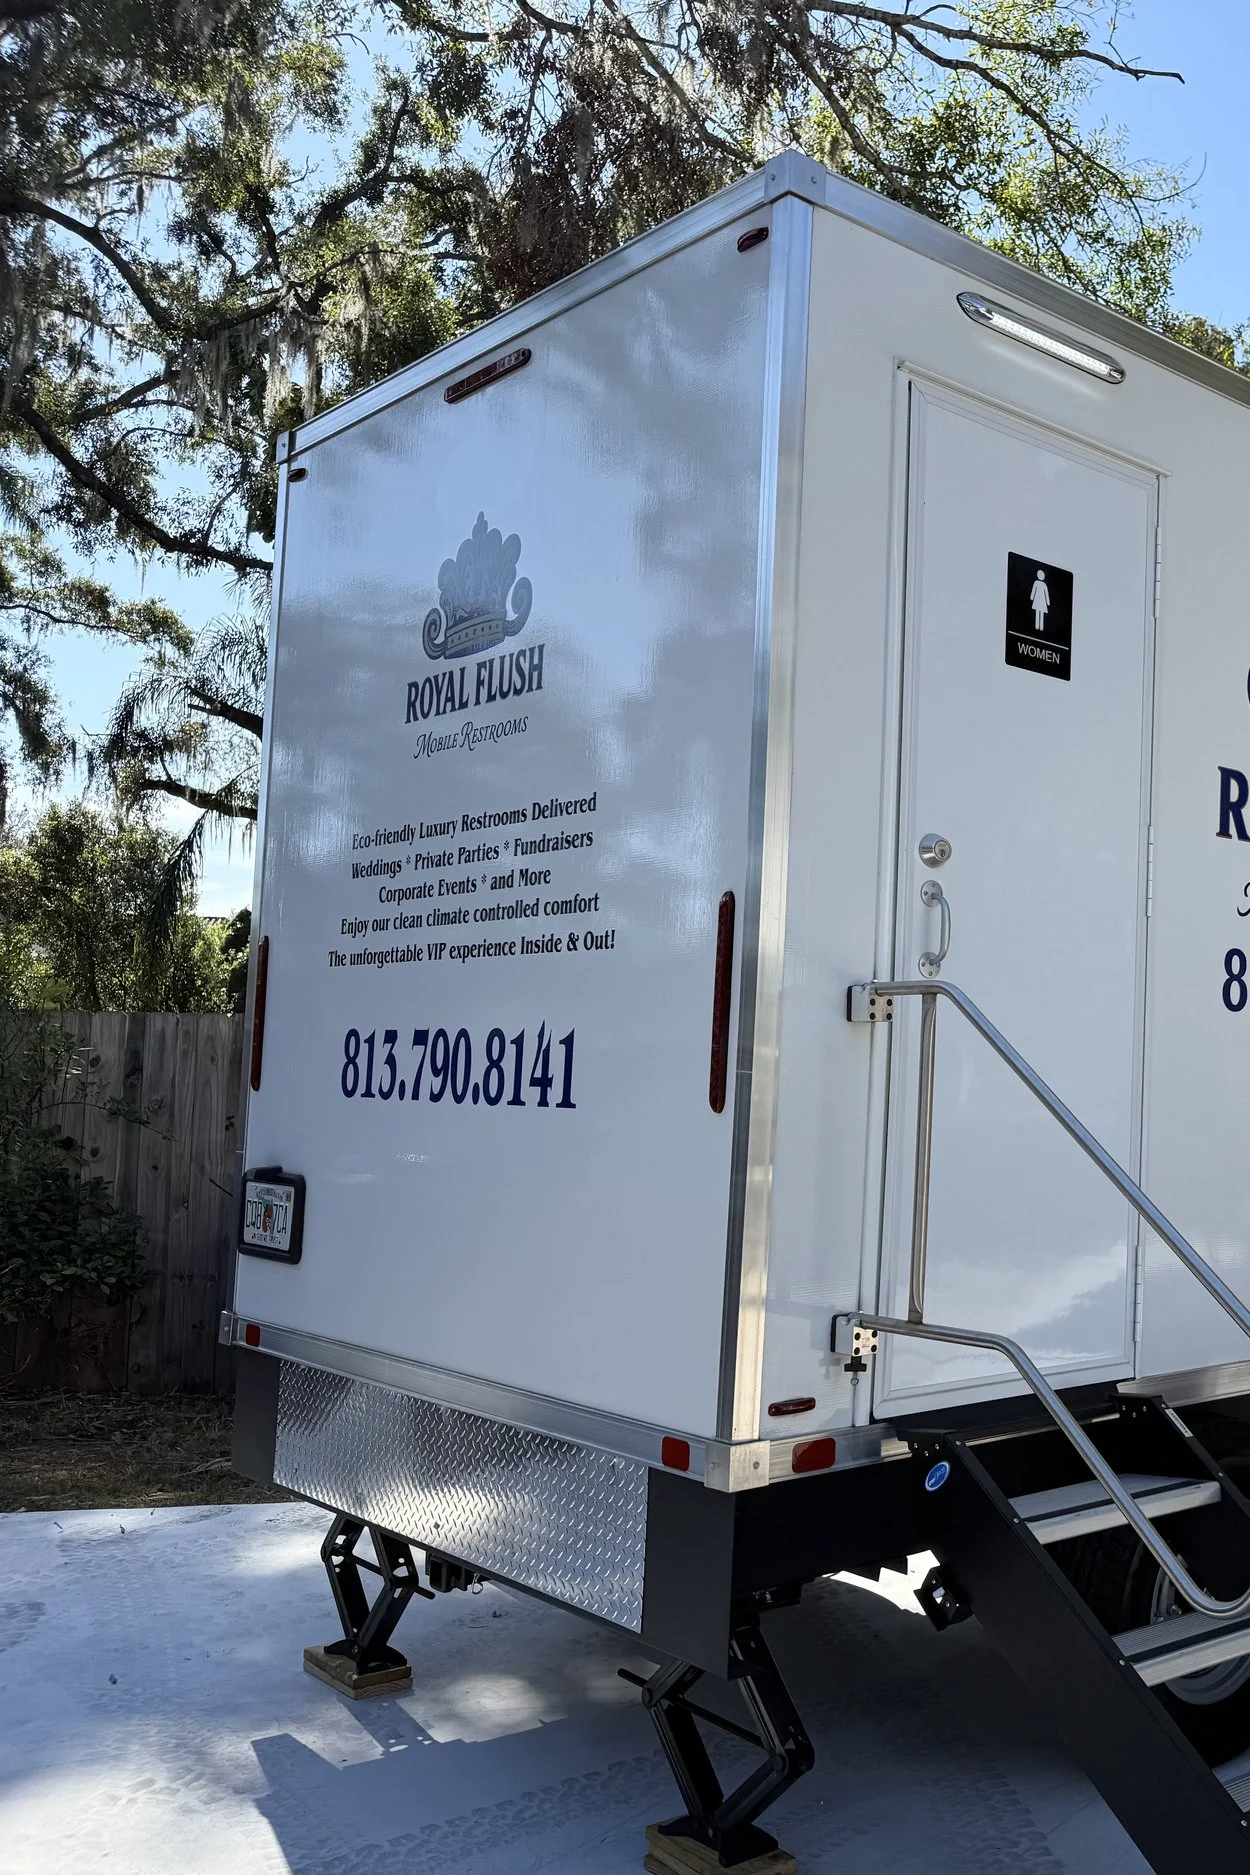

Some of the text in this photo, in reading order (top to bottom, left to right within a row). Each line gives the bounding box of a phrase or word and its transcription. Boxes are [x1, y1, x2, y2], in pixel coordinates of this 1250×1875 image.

[1017, 642, 1060, 664] WOMEN
[404, 643, 545, 724] ROYAL FLUSH
[352, 791, 597, 850] Eco-friendly Luxury Restrooms Delivered
[351, 830, 593, 879] Weddings Private Parties Fundraisers
[378, 866, 551, 905] Corporate Events and More
[341, 892, 599, 938] Enjoy our clean climate controlled comfort
[328, 929, 616, 969] The unforgettable VIP experience Inside & Out!
[341, 1018, 577, 1109] 813.790.8141
